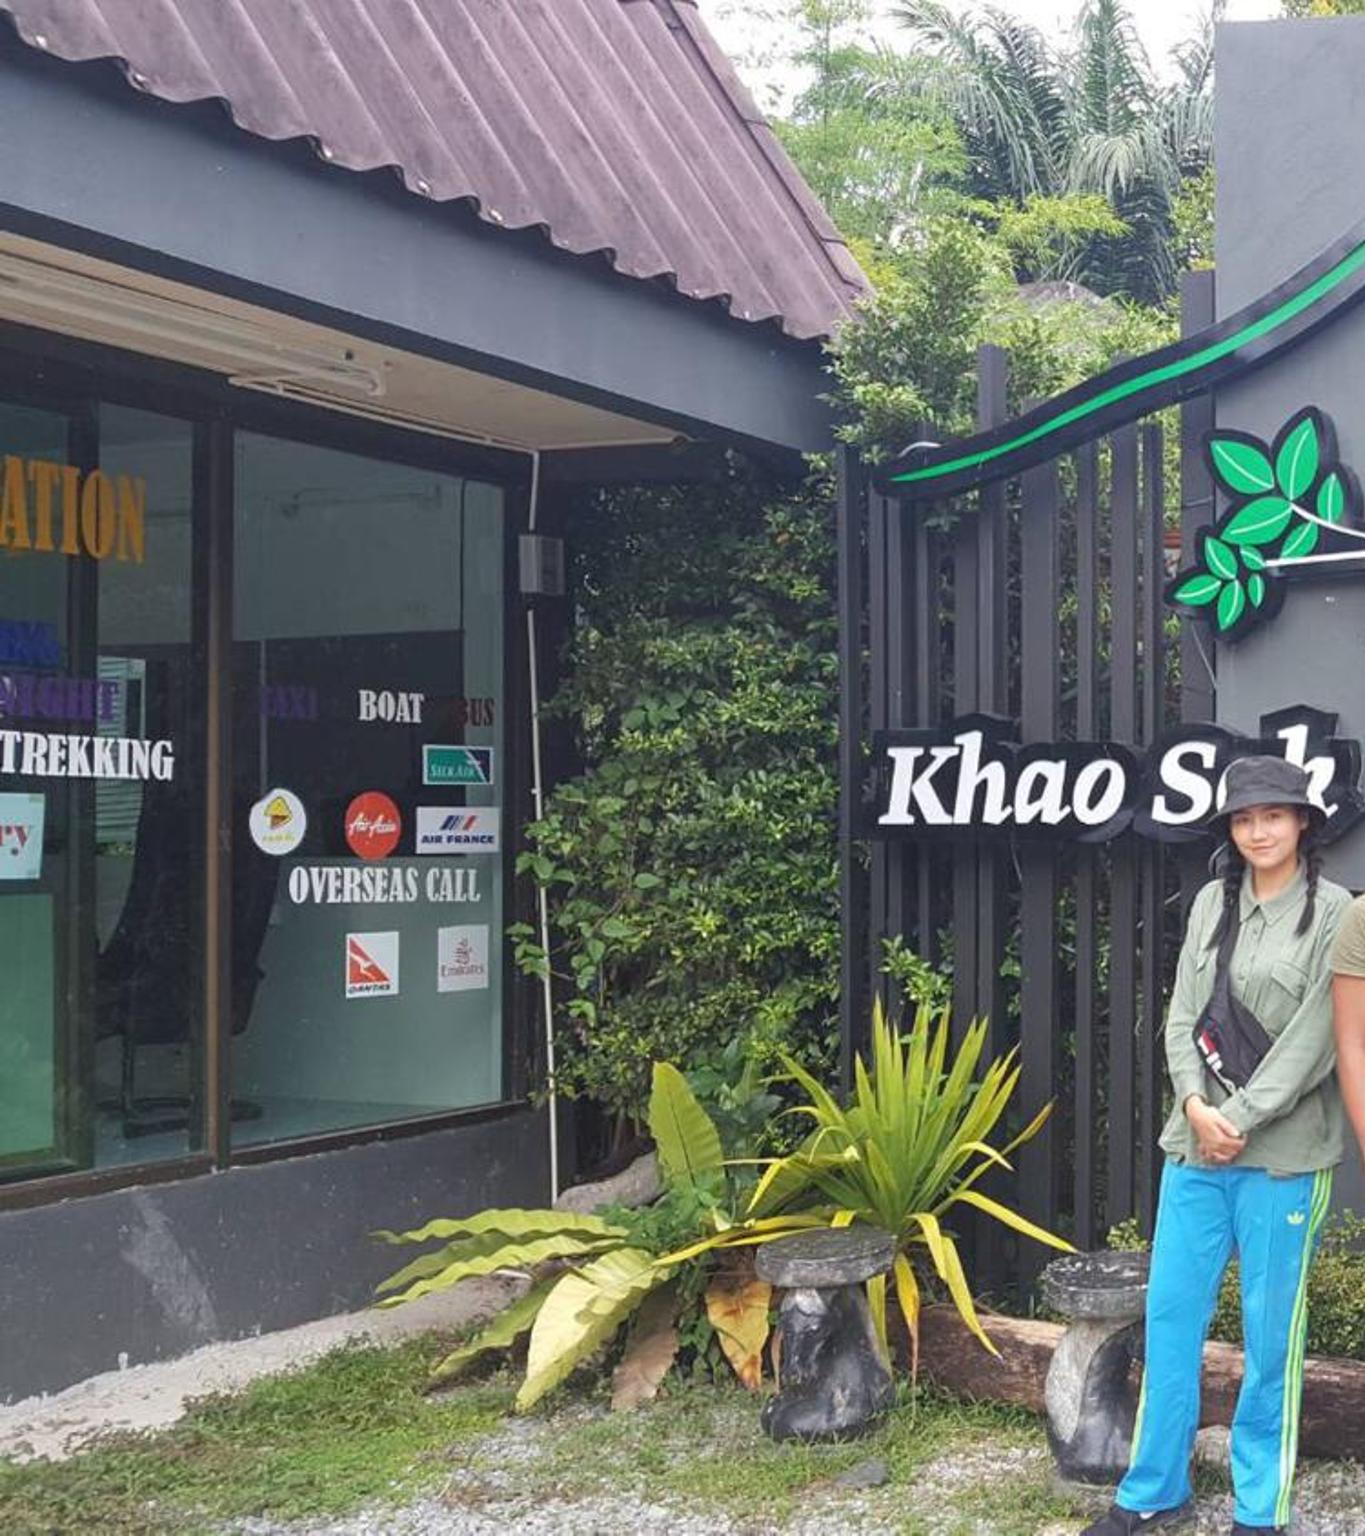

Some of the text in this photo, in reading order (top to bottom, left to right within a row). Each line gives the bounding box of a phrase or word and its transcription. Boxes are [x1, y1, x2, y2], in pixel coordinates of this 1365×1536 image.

[358, 689, 424, 724] BOAT
[0, 729, 174, 781] TREKKING
[878, 724, 1339, 826] Khao Sk
[421, 834, 495, 845] AIR FRANCE
[289, 866, 481, 904] OVERSEAS CALL
